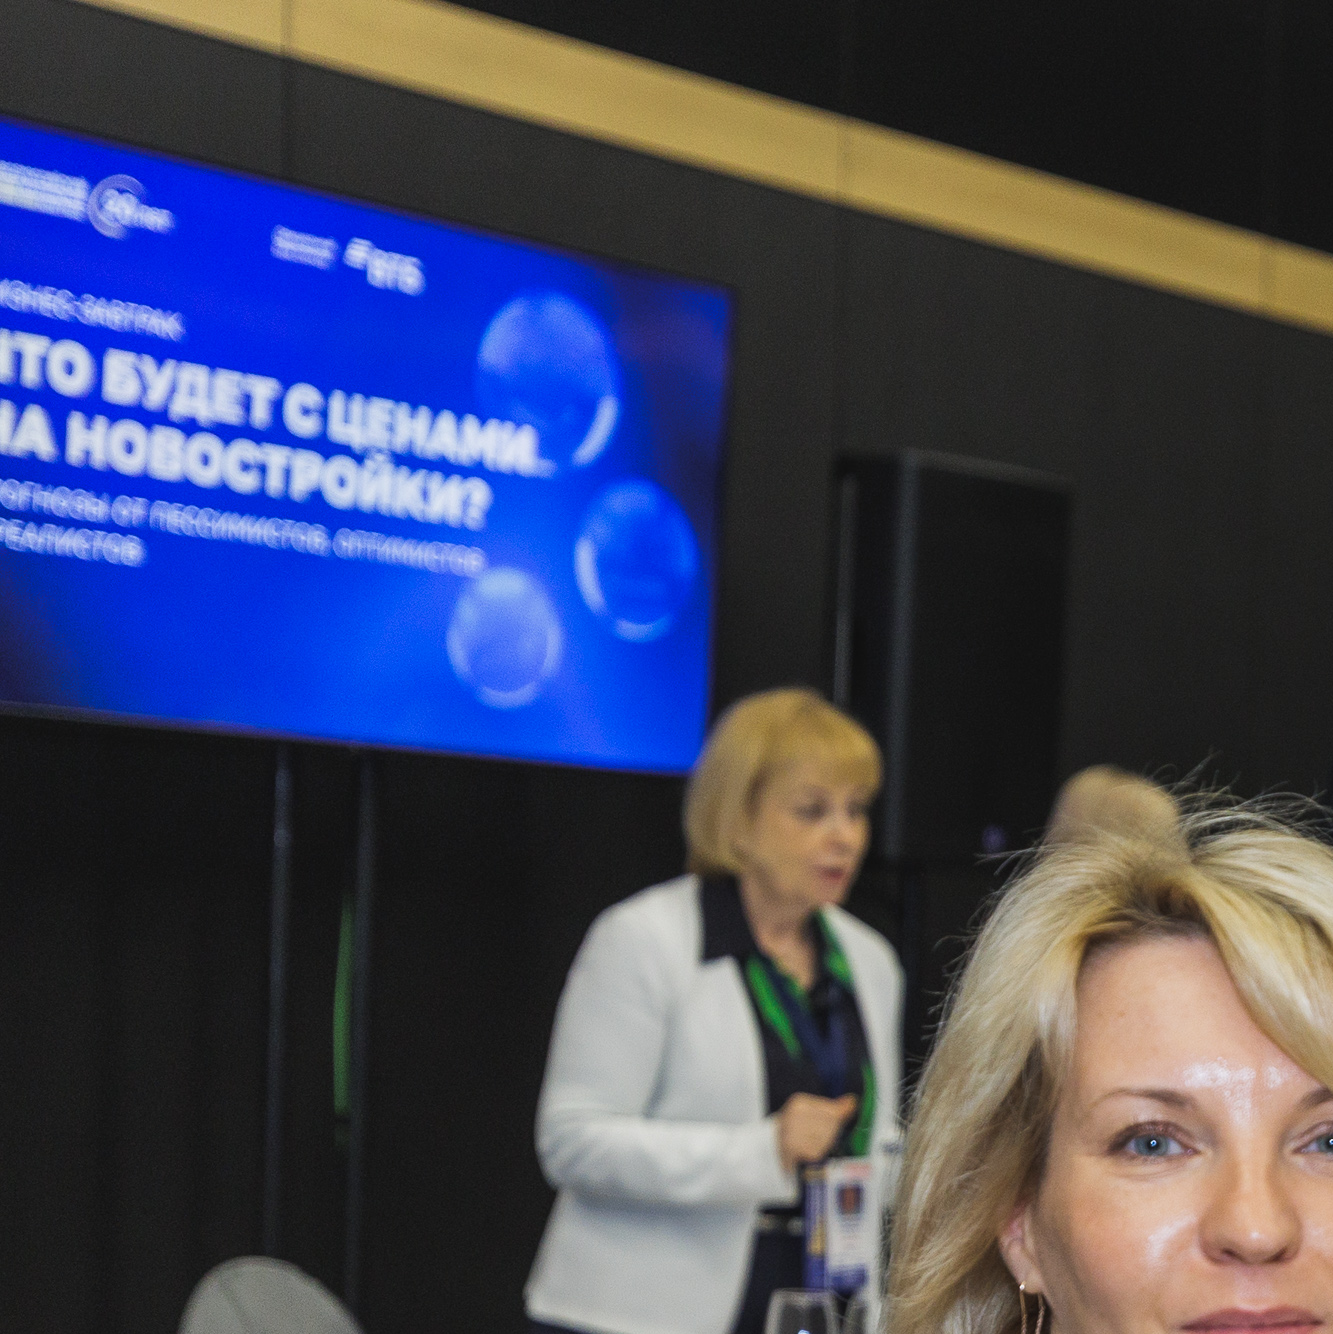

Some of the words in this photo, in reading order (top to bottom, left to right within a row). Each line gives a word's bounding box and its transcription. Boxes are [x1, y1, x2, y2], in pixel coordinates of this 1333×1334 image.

[65, 410, 493, 531] НОВОСТРОЙКИ?
[102, 347, 283, 431] БУДЕТ
[283, 381, 325, 440] С
[327, 388, 540, 478] ЦЕНАМИ
